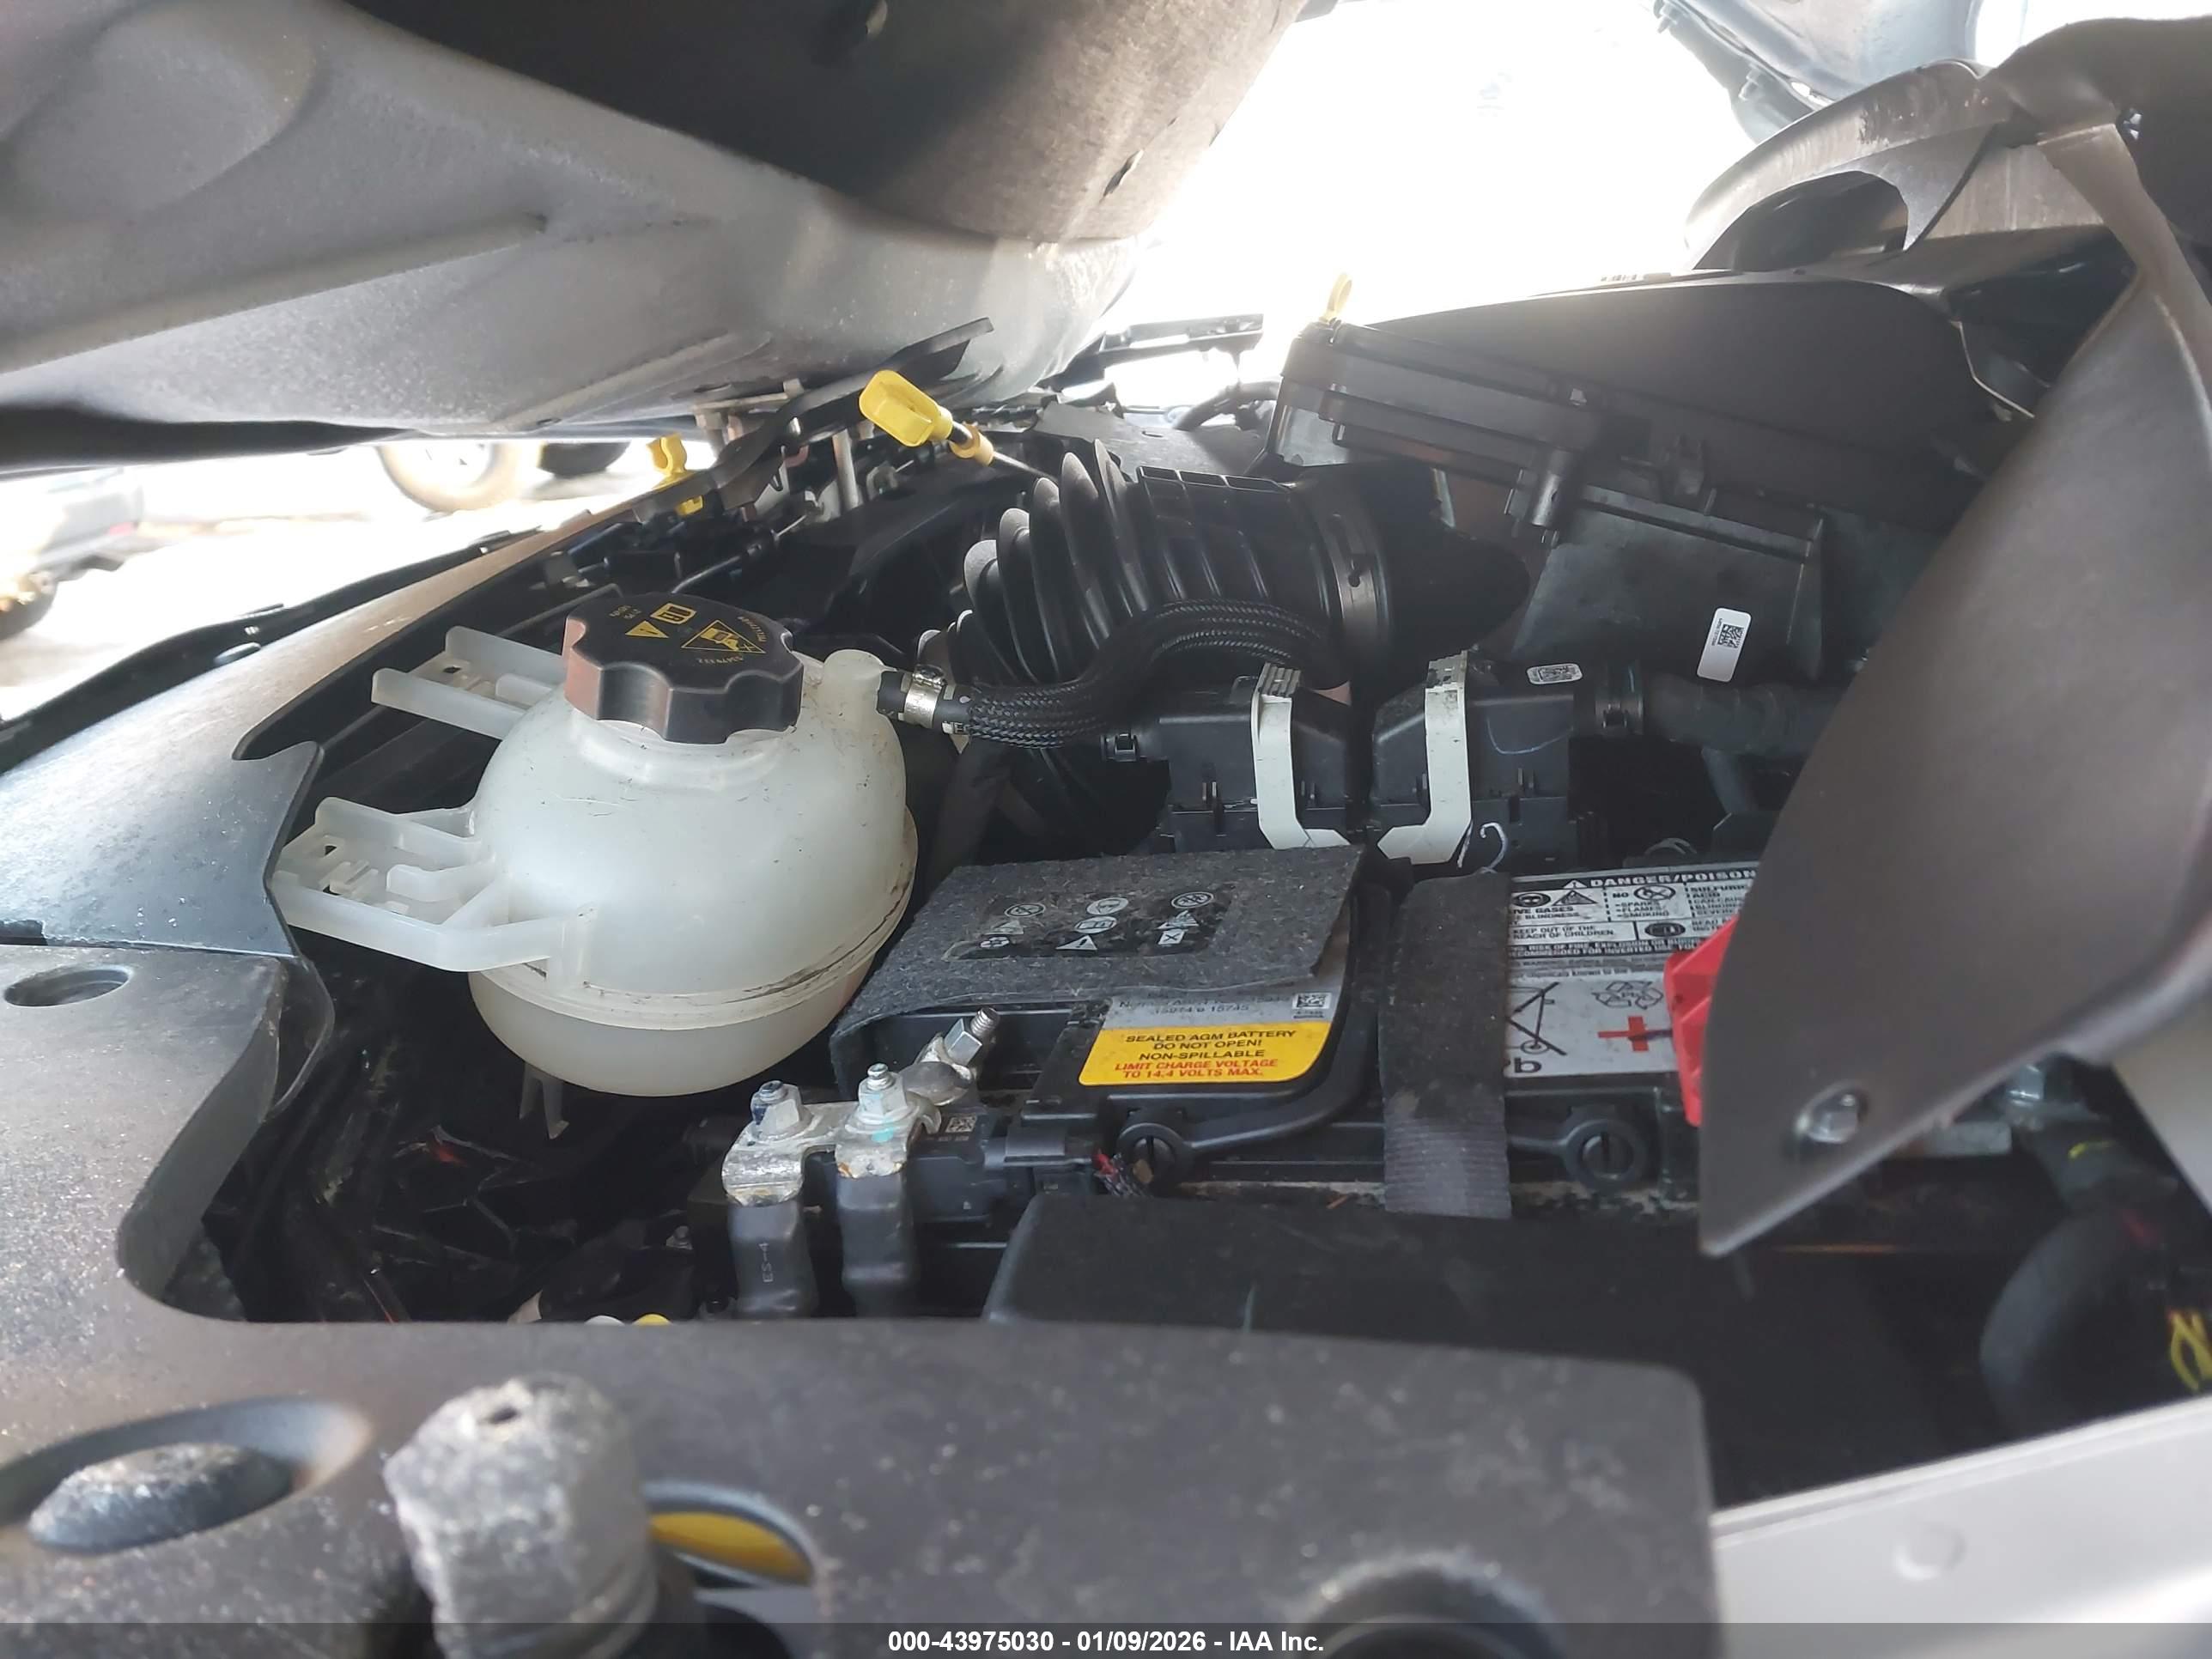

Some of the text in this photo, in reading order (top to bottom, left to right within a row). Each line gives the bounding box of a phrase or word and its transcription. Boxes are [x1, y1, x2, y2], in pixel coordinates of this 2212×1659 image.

[1589, 870, 1756, 887] DANGER/POISON
[1126, 1034, 1186, 1042] SEALED
[1228, 1030, 1297, 1039] BATTERY
[1139, 1049, 1265, 1060] NON-SPILLABLE
[1156, 1060, 1212, 1069] CHARGE
[1215, 1058, 1279, 1067] VOLTAGE
